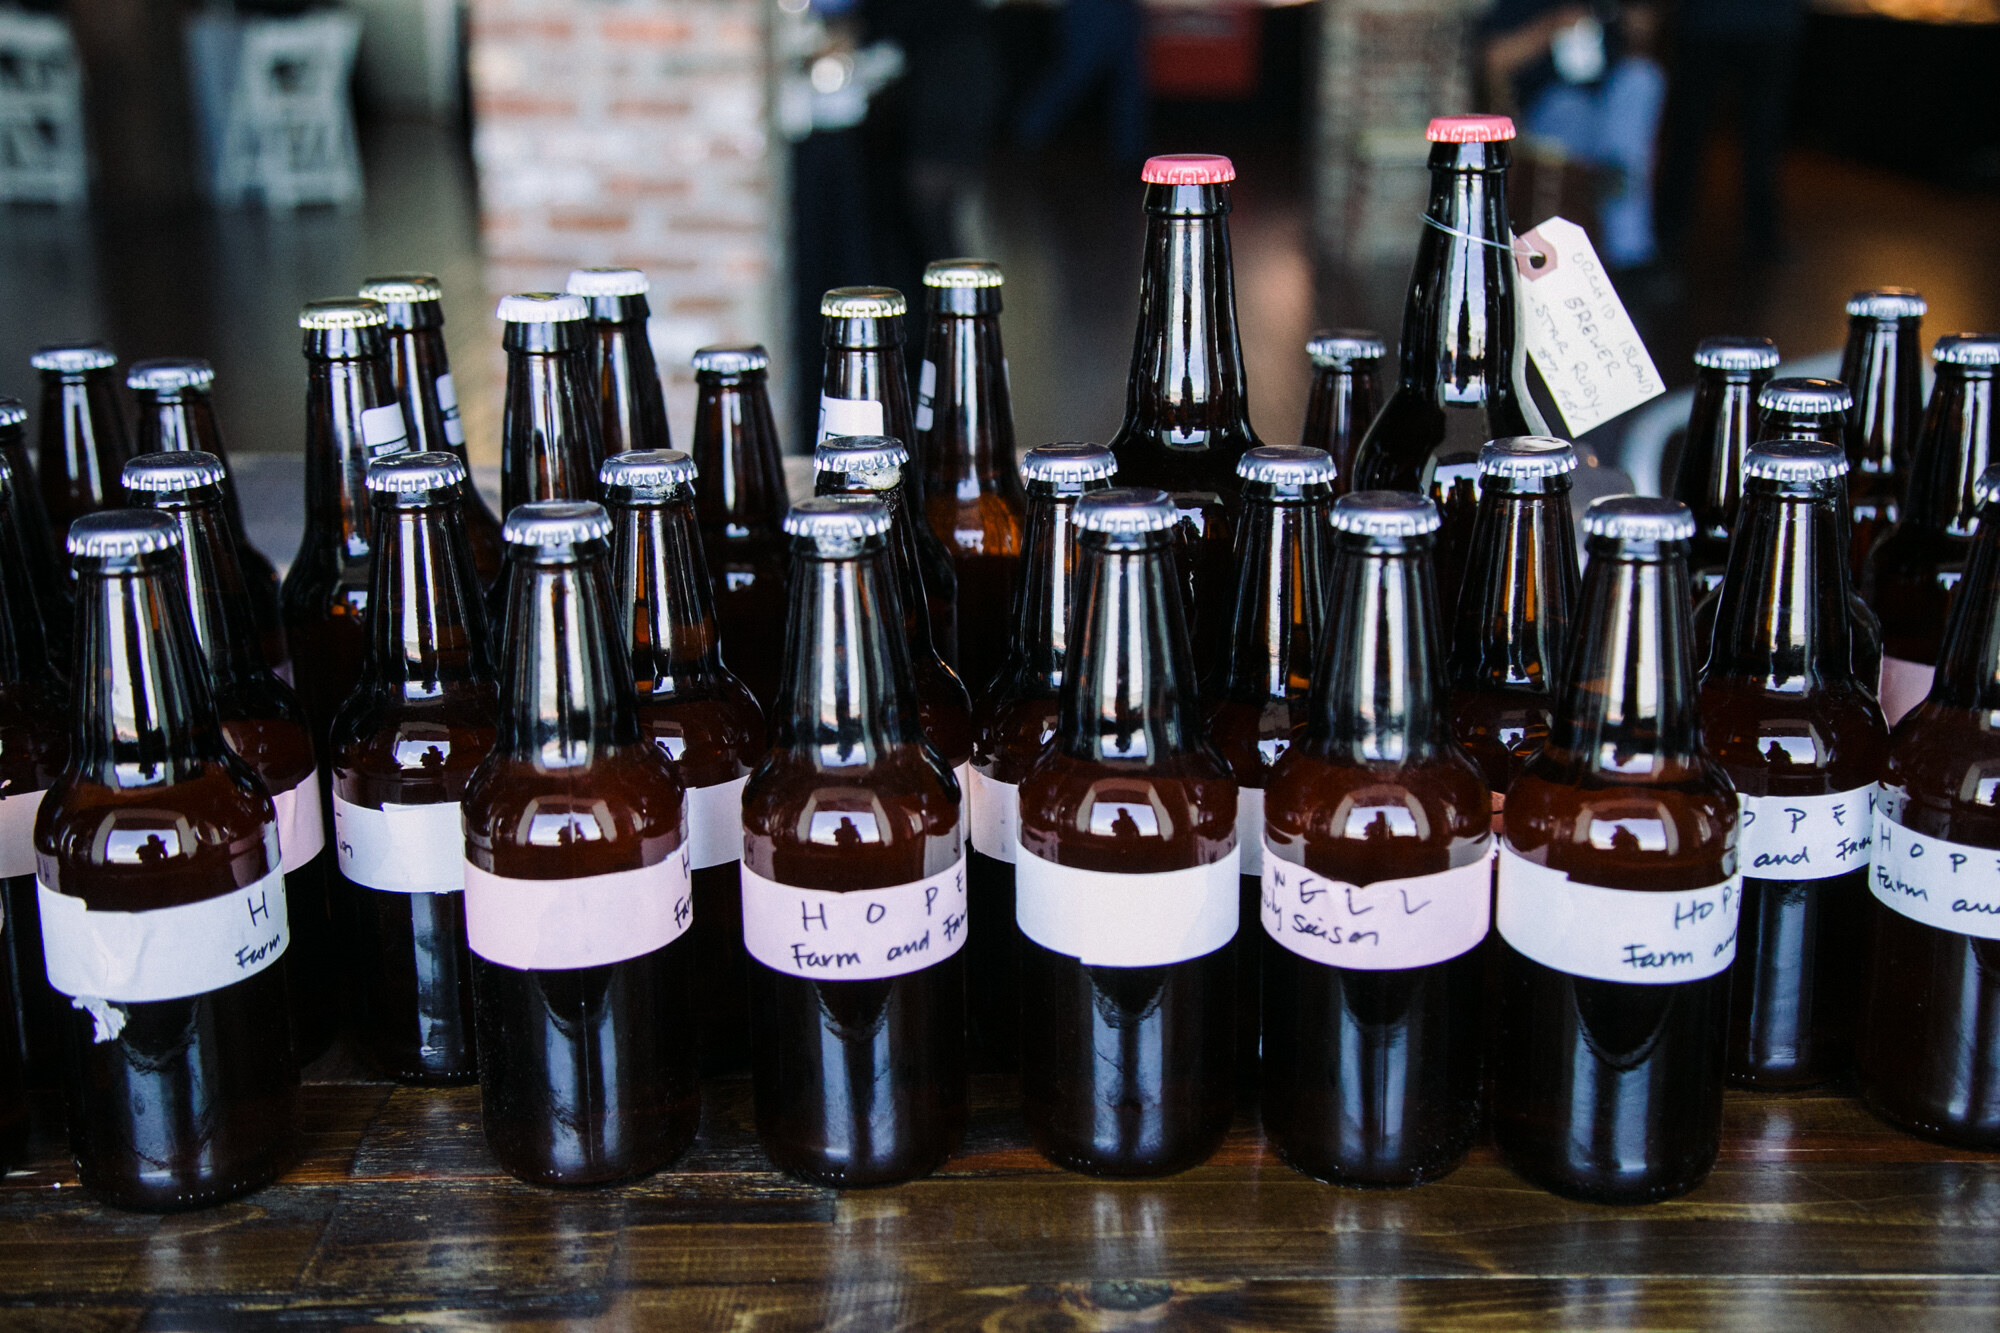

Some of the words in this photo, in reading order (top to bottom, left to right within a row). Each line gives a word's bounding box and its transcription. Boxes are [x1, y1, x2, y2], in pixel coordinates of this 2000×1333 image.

[1572, 252, 1615, 320] ORCHID
[1619, 340, 1654, 394] ISLAND
[1753, 846, 1810, 868] and
[1880, 822, 2000, 873] HOP
[1877, 865, 1928, 902] Farm
[235, 933, 280, 969] Farm
[791, 943, 861, 970] Farm
[887, 930, 929, 961] and
[1622, 944, 1693, 968] Farm
